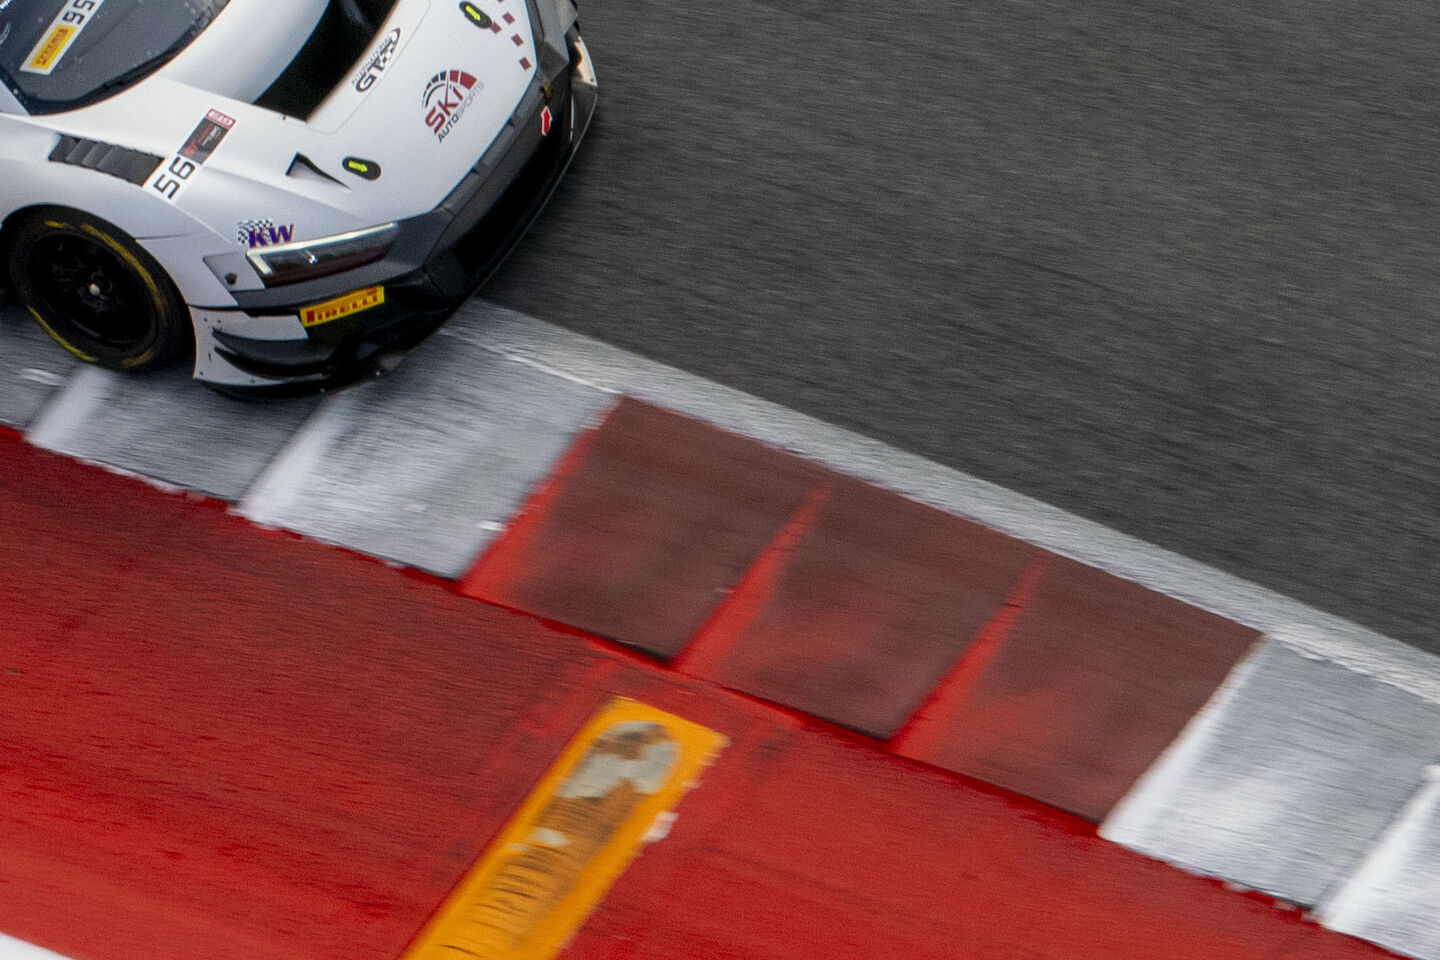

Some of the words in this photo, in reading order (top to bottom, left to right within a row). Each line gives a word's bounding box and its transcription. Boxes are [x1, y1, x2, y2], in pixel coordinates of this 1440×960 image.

[438, 81, 484, 143] AUTOSPORTS
[153, 157, 195, 199] 56
[248, 223, 295, 248] KW
[306, 288, 378, 323] PIRELLI
